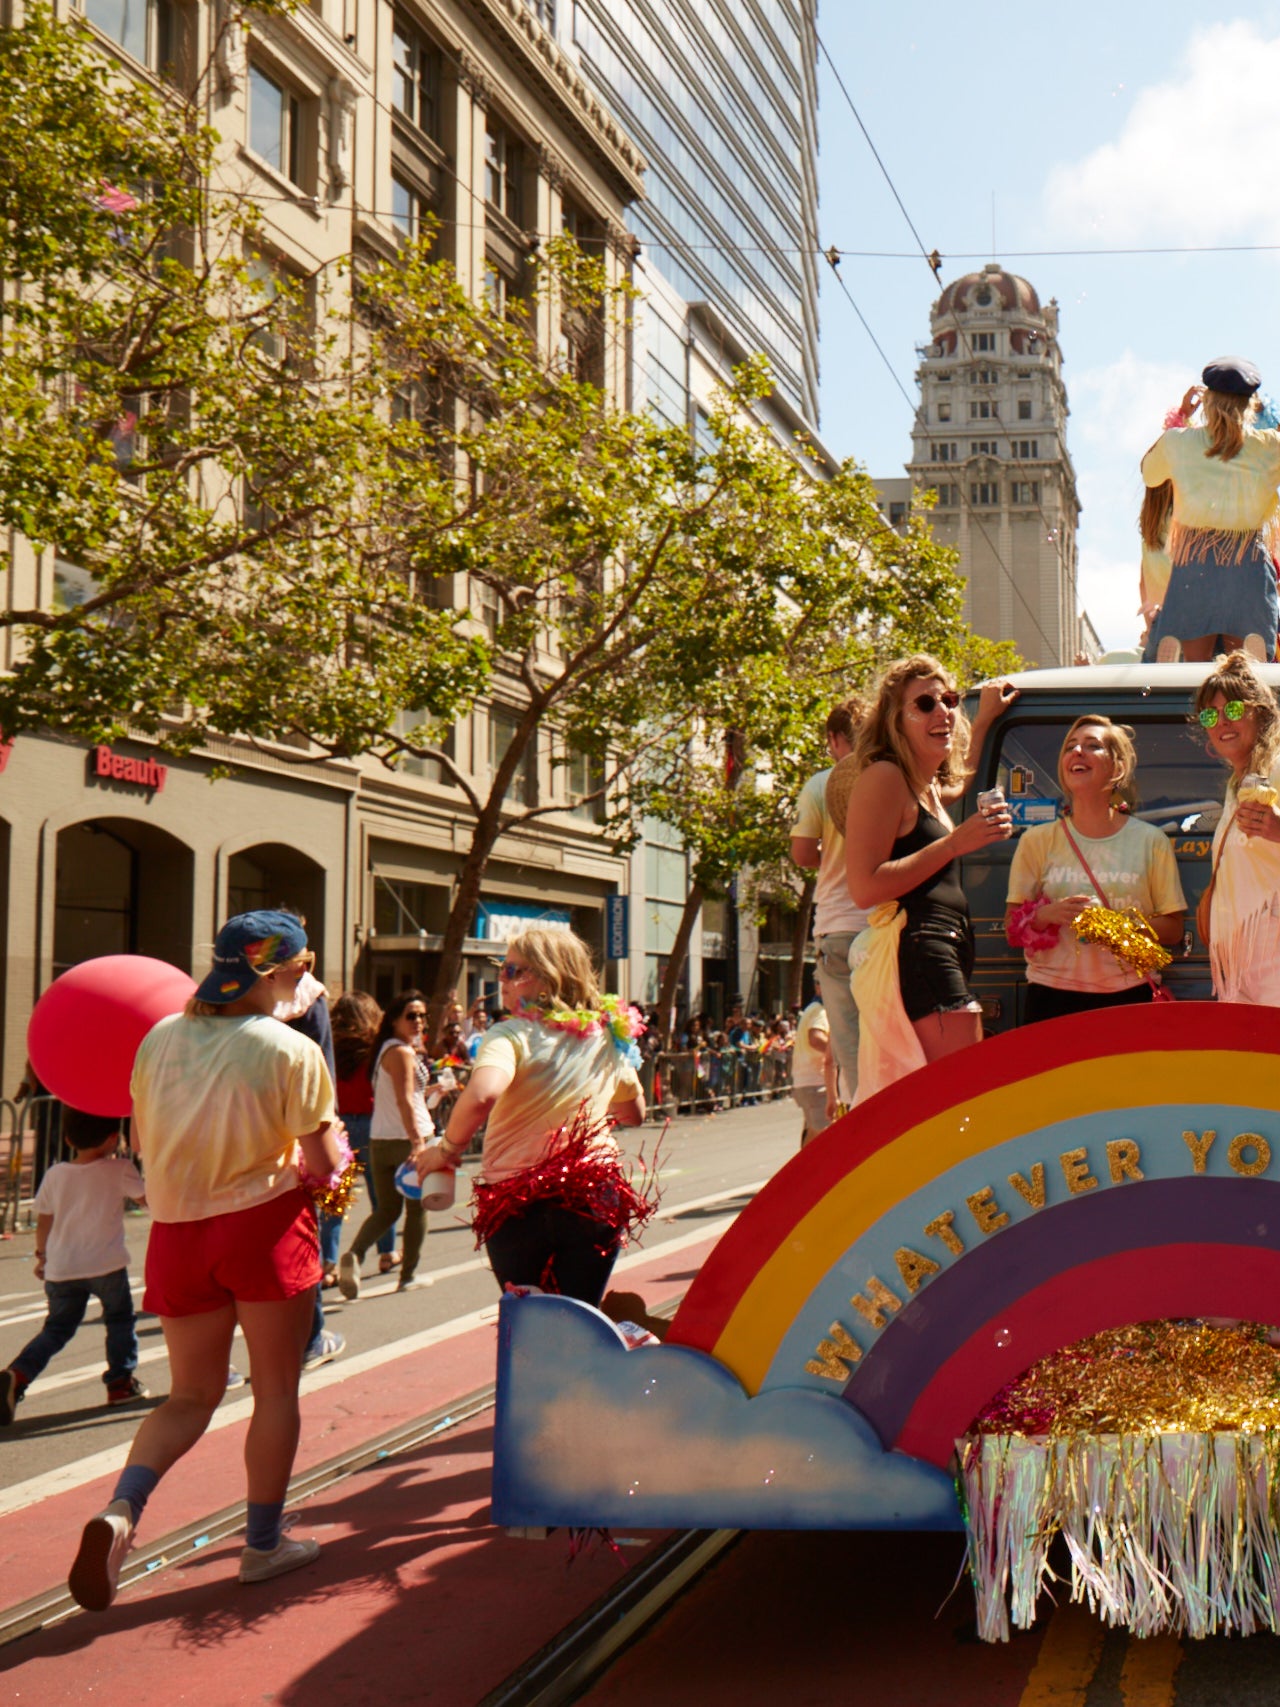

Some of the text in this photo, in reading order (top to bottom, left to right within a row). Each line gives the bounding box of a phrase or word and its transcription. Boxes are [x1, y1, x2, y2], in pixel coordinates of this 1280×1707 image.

[96, 744, 168, 793] Beauty
[1048, 866, 1140, 885] Whaever
[804, 1137, 1145, 1382] WHATEVER
